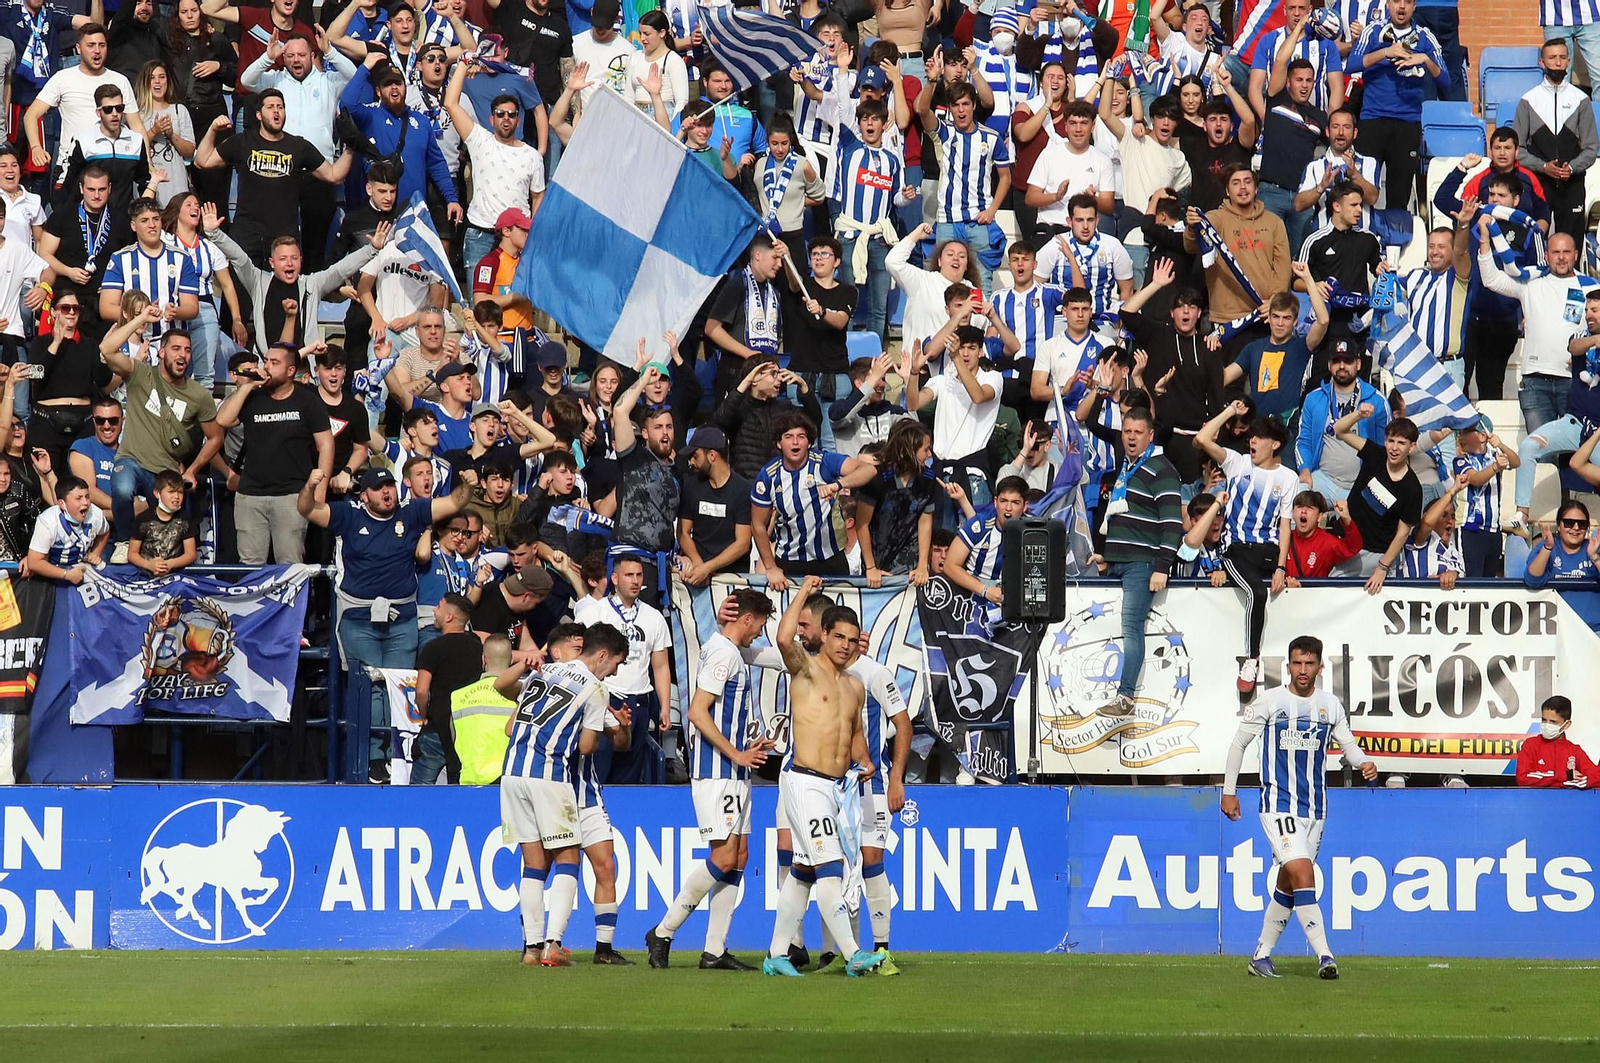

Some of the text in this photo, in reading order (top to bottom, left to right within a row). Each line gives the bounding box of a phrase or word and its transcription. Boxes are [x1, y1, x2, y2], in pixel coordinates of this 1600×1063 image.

[250, 150, 292, 176] EVERLAST
[383, 262, 429, 282] ellesse
[253, 411, 301, 423] SANCIONADOS
[1383, 600, 1558, 636] SECTOR
[557, 668, 588, 686] LIMON
[1235, 642, 1556, 718] HLICÓST
[181, 683, 228, 700] LIFE
[516, 679, 577, 728] 27
[1056, 729, 1094, 747] Sector
[1122, 734, 1185, 760] Gol Sur
[1342, 736, 1402, 753] ANO
[1410, 738, 1451, 755] DEL
[723, 795, 742, 814] 21
[809, 817, 834, 839] 20
[1275, 816, 1297, 836] 10
